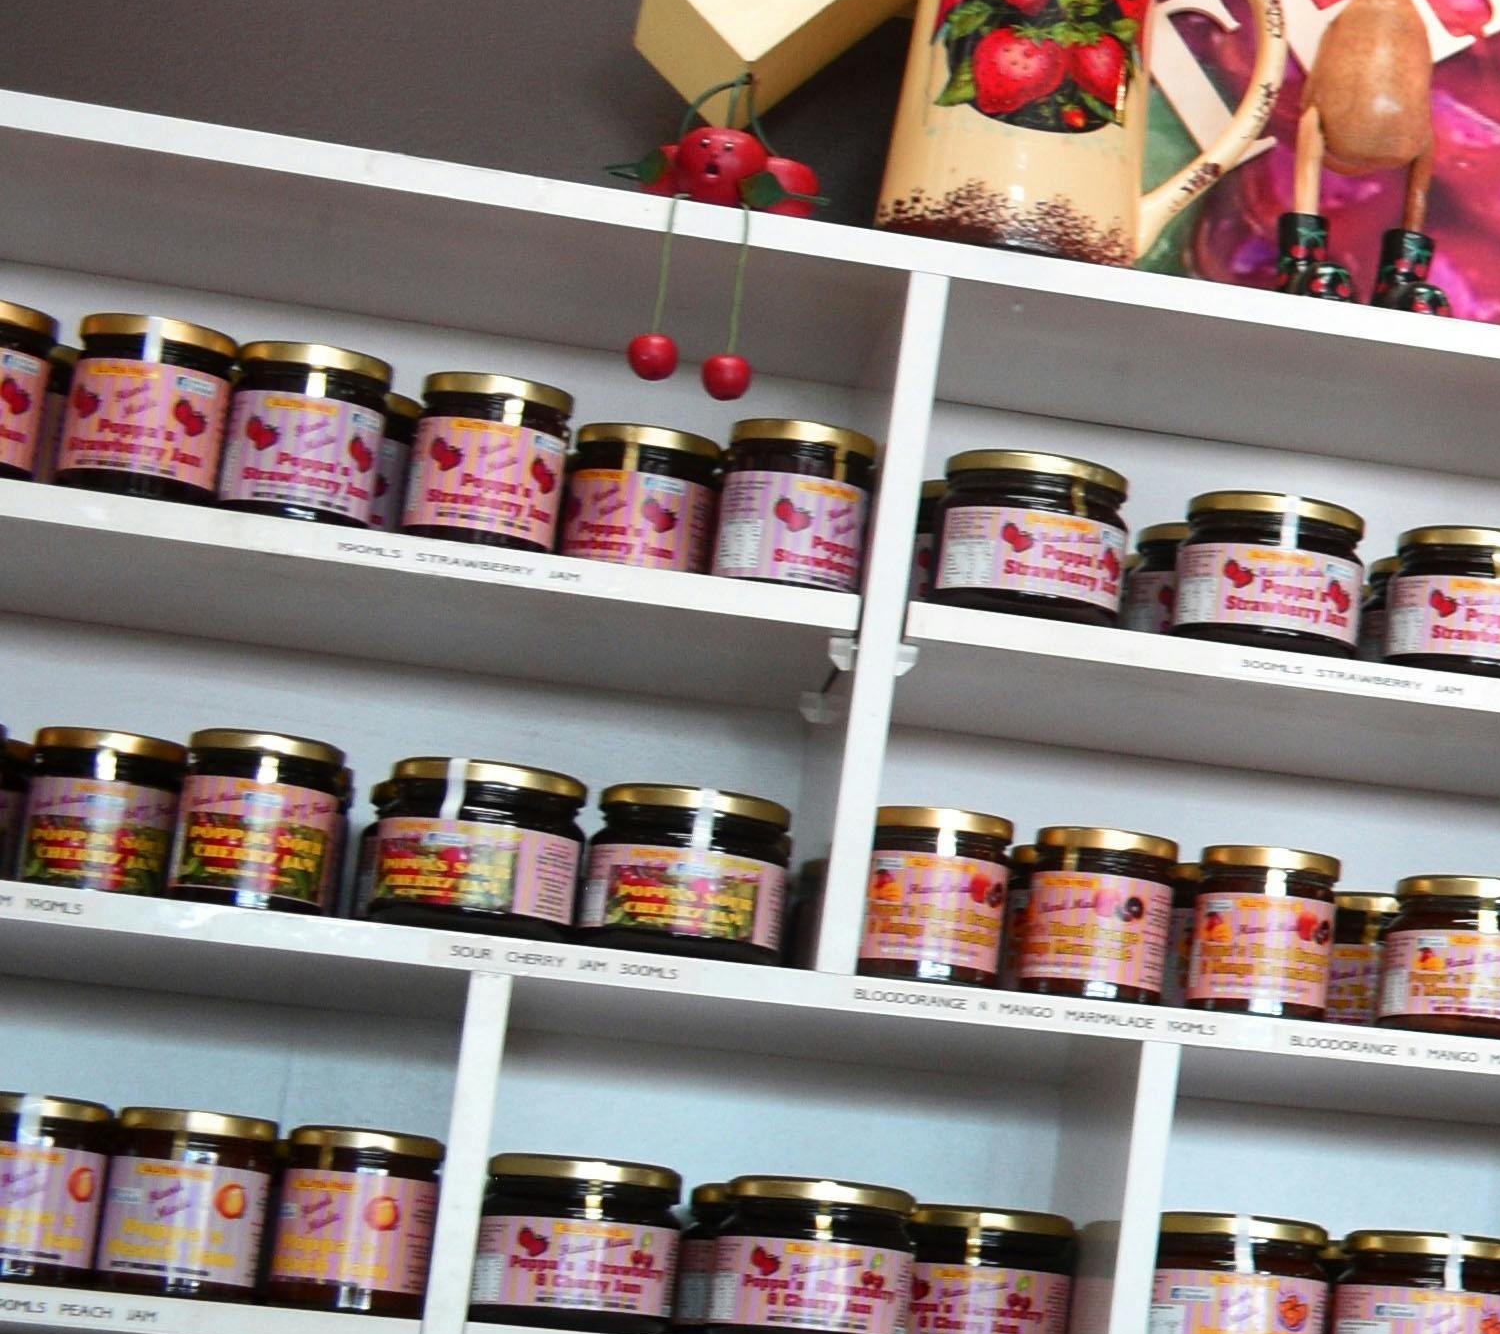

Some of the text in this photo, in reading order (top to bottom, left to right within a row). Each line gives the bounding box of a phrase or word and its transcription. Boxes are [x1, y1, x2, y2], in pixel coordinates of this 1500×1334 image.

[450, 944, 493, 960] SOUR
[505, 951, 566, 969] CHERRY
[577, 959, 607, 973] JAM
[999, 1003, 1054, 1019] MANGO
[1065, 1011, 1155, 1030] MARMALADE
[1427, 1050, 1480, 1064] MANGO
[60, 1304, 113, 1320] PEACH
[126, 1309, 158, 1323] JAM
